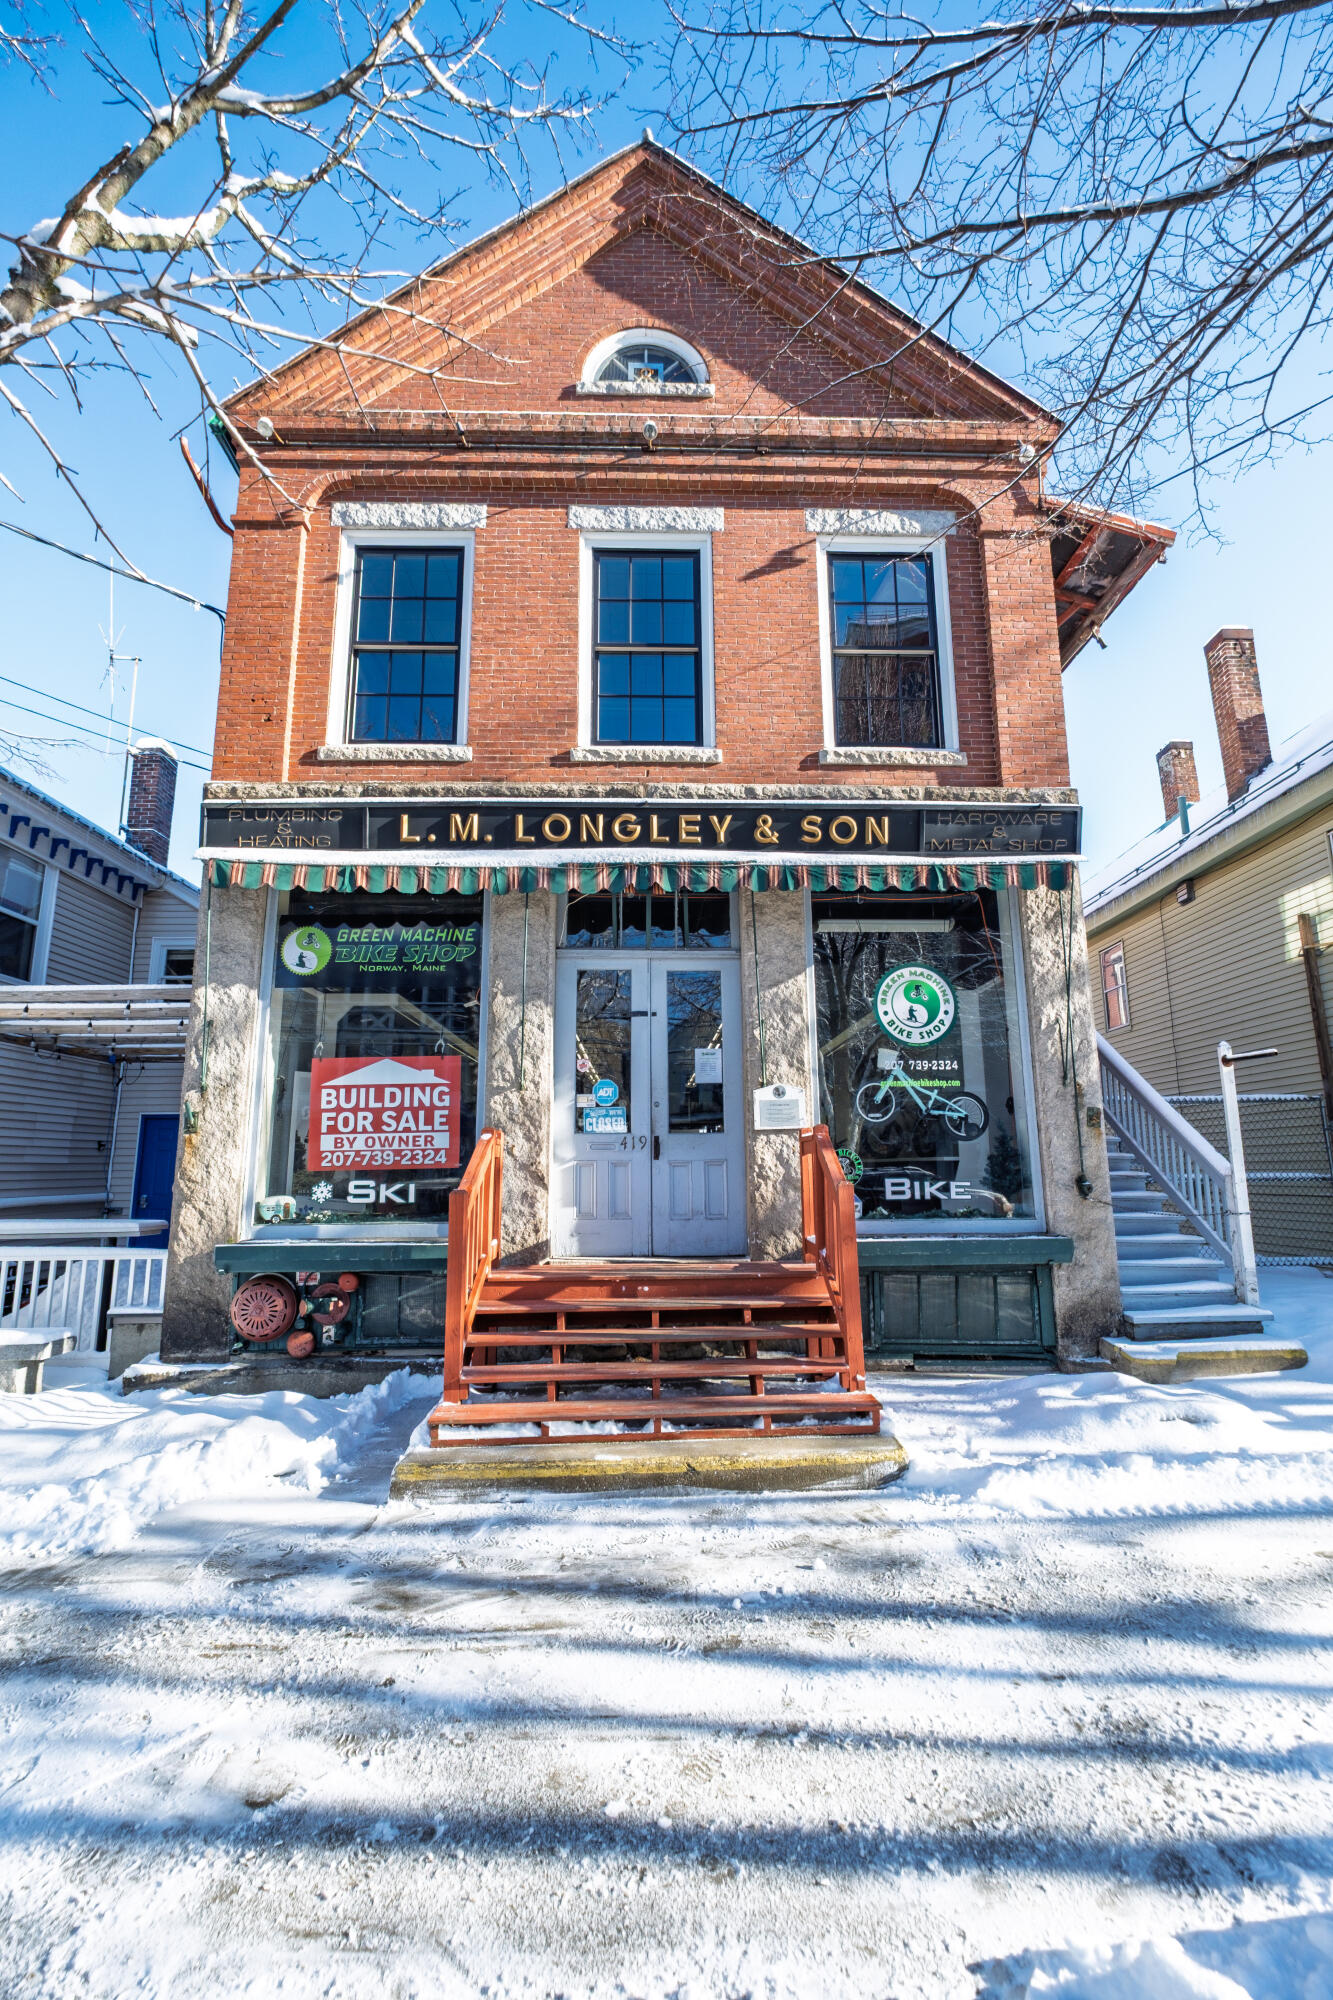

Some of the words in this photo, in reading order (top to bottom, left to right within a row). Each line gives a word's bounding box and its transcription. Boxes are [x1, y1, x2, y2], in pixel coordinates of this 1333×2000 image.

[228, 809, 343, 822] PLUMBING
[937, 812, 1063, 825] HARDWARE
[277, 822, 293, 834] &
[515, 813, 733, 844] LONGLEY
[753, 814, 780, 844] &
[800, 815, 889, 845] SON
[992, 826, 1008, 838] &
[238, 835, 331, 848] HEATING
[930, 838, 1000, 851] METAL
[1008, 839, 1068, 851] SHOP
[337, 929, 393, 942] GREEN
[400, 928, 477, 942] MACHINE
[335, 945, 398, 962] BIKE
[402, 944, 477, 964] SHOP
[880, 972, 905, 1006] GREEN
[909, 970, 951, 1005] MACHINE
[887, 1019, 913, 1039] BIKE
[919, 1018, 946, 1040] SHOP
[885, 1060, 904, 1070] 207
[320, 1086, 450, 1109] BUILDING
[598, 1087, 614, 1097] ADT
[321, 1111, 374, 1133] FOR
[381, 1109, 449, 1132] SALE
[585, 1116, 626, 1132] CLOSED
[333, 1137, 357, 1149] BY
[364, 1134, 435, 1148] OWNER
[620, 1136, 647, 1150] 419
[321, 1149, 447, 1167] 207-739-2324
